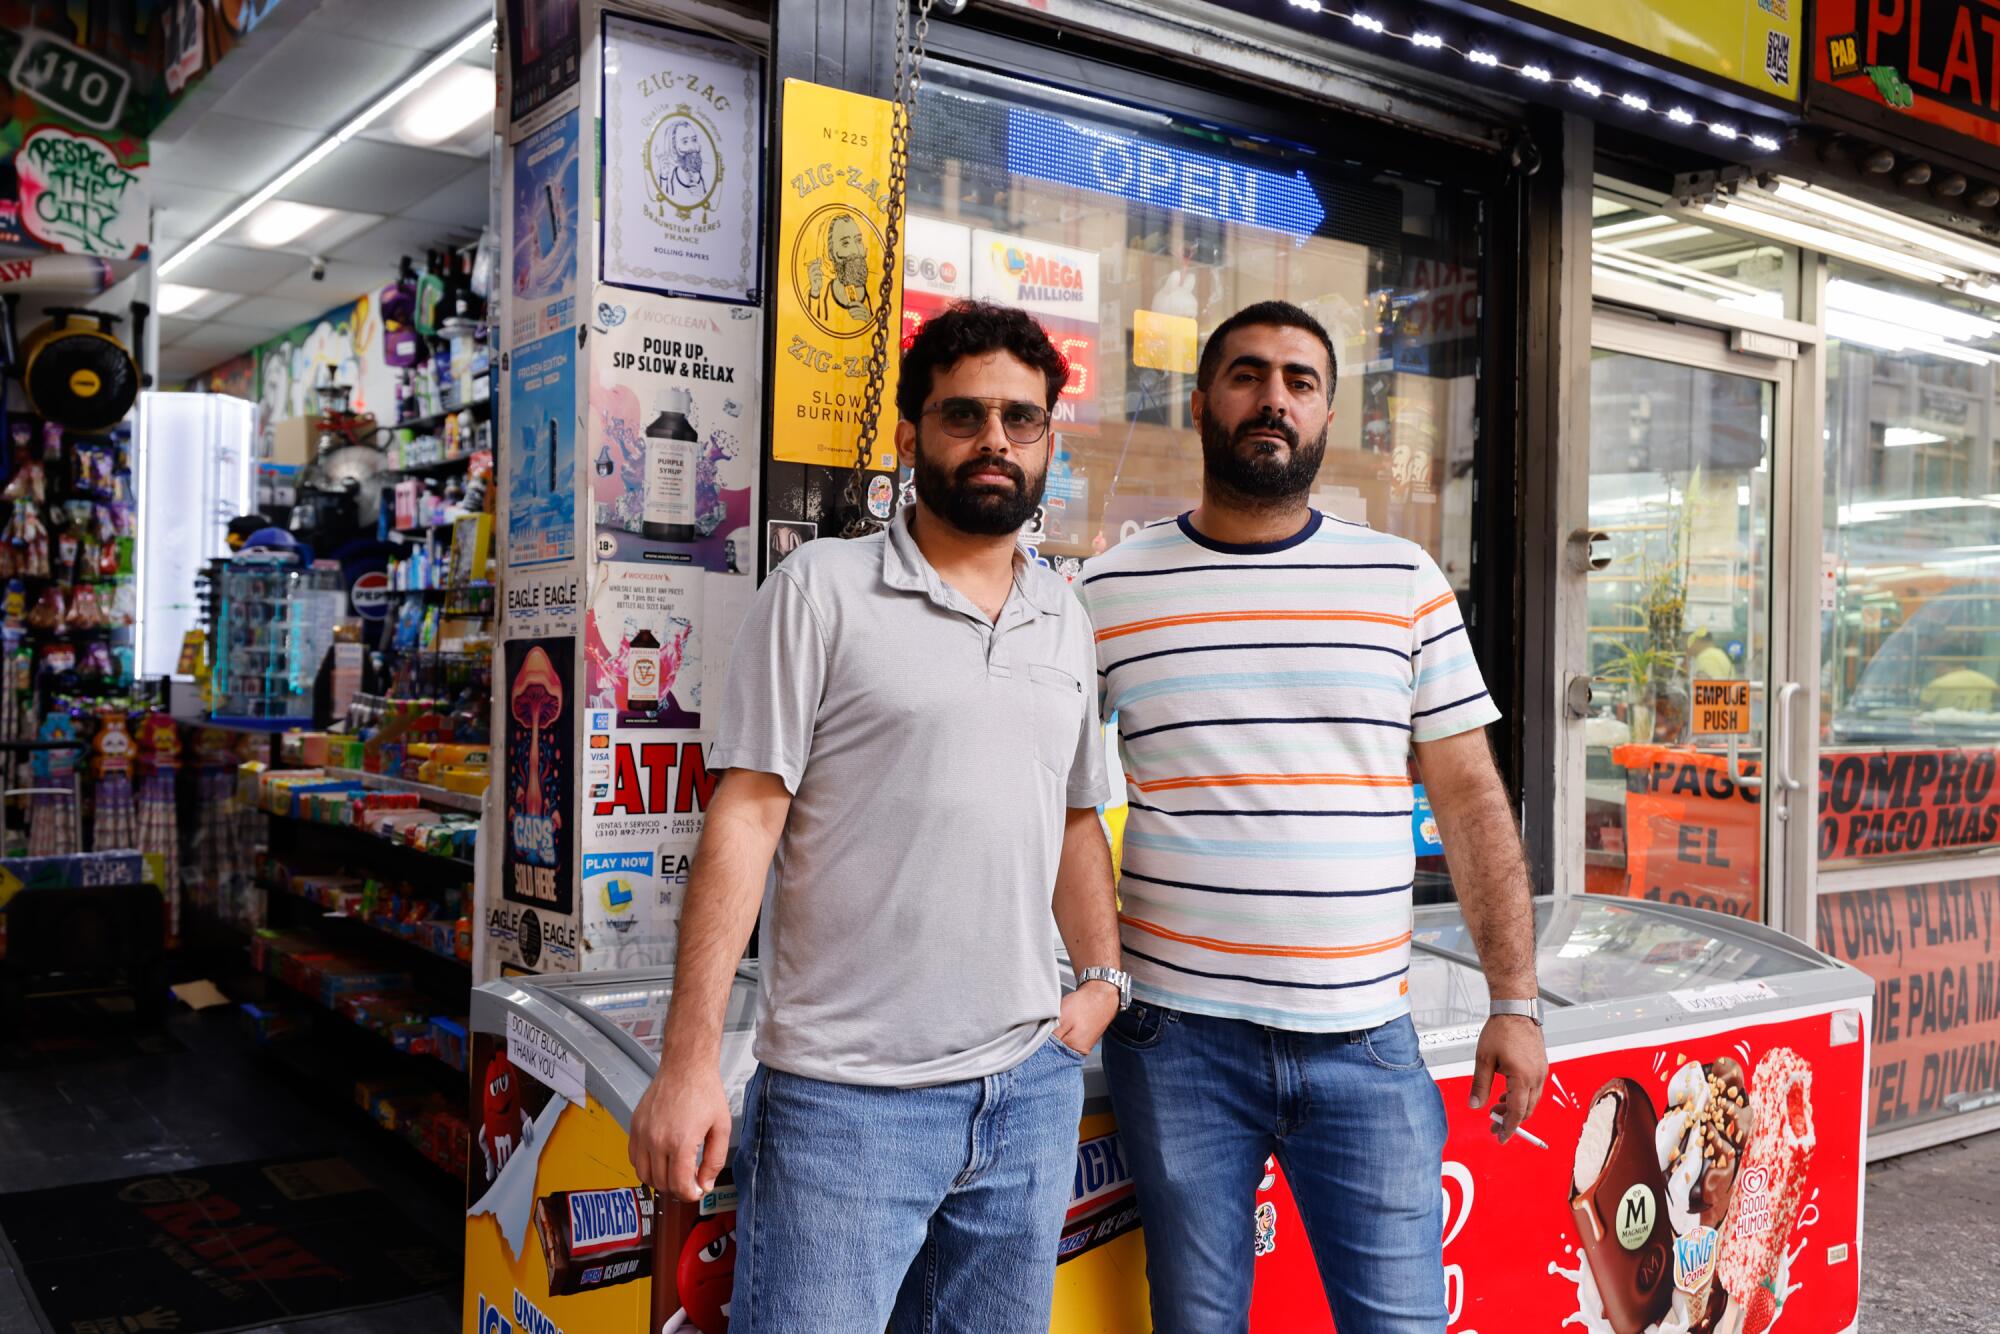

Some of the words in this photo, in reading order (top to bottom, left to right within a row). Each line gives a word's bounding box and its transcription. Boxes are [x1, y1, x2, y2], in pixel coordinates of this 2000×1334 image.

[1830, 37, 1857, 68] PAB
[638, 70, 732, 112] ZIG-ZAG
[28, 138, 139, 197] RESPECT
[1091, 138, 1258, 223] OPEN
[49, 170, 107, 203] THE
[36, 191, 120, 238] CITY
[654, 246, 684, 258] ROLLING
[685, 250, 710, 261] PAPERS
[1020, 252, 1083, 290] MEGA
[1017, 285, 1083, 302] MILLIONS
[643, 337, 681, 358] POUR
[685, 343, 708, 363] UP,
[788, 335, 890, 378] ZIG-Z
[613, 352, 635, 369] SIP
[638, 355, 676, 376] SLOW
[680, 363, 689, 378] &
[693, 362, 734, 383] RELAX
[813, 390, 861, 408] SLOW
[797, 405, 870, 425] BURNIN
[657, 458, 684, 467] PURPLE
[659, 467, 682, 475] SYRUP
[599, 541, 613, 551] 18+
[508, 580, 539, 609] EAGLE
[544, 577, 577, 606] EAGLE
[1695, 686, 1747, 706] EMPUJE
[1704, 709, 1738, 731] PUSH
[1819, 751, 1997, 815] COMPRO
[513, 815, 553, 850] CAPS
[596, 821, 622, 830] VENTAS
[629, 820, 660, 829] SERVICIO
[672, 820, 695, 828] SALES
[1844, 810, 1928, 857] PAGO
[1931, 803, 2000, 848] MAS
[1678, 824, 1731, 869] EL
[585, 858, 617, 870] PLAY
[621, 856, 650, 868] NOW
[515, 862, 534, 897] SOLD
[534, 865, 557, 902] HERE
[1905, 879, 1978, 949] PLATA
[544, 919, 575, 949] EAGLE
[1906, 966, 1969, 1039] PAGA
[512, 1016, 523, 1036] DO
[524, 1024, 540, 1046] NOT
[541, 1033, 568, 1064] BLOCK
[513, 1039, 536, 1067] THANK
[538, 1055, 556, 1079] YOU
[571, 1189, 638, 1242] SNICKERS
[1625, 1195, 1647, 1230] M
[1741, 1194, 1766, 1217] GOOD
[1094, 1215, 1115, 1241] ICE
[1622, 1224, 1649, 1239] MAGNUM
[1736, 1211, 1770, 1237] HUMOR
[1683, 1266, 1708, 1287] Cone
